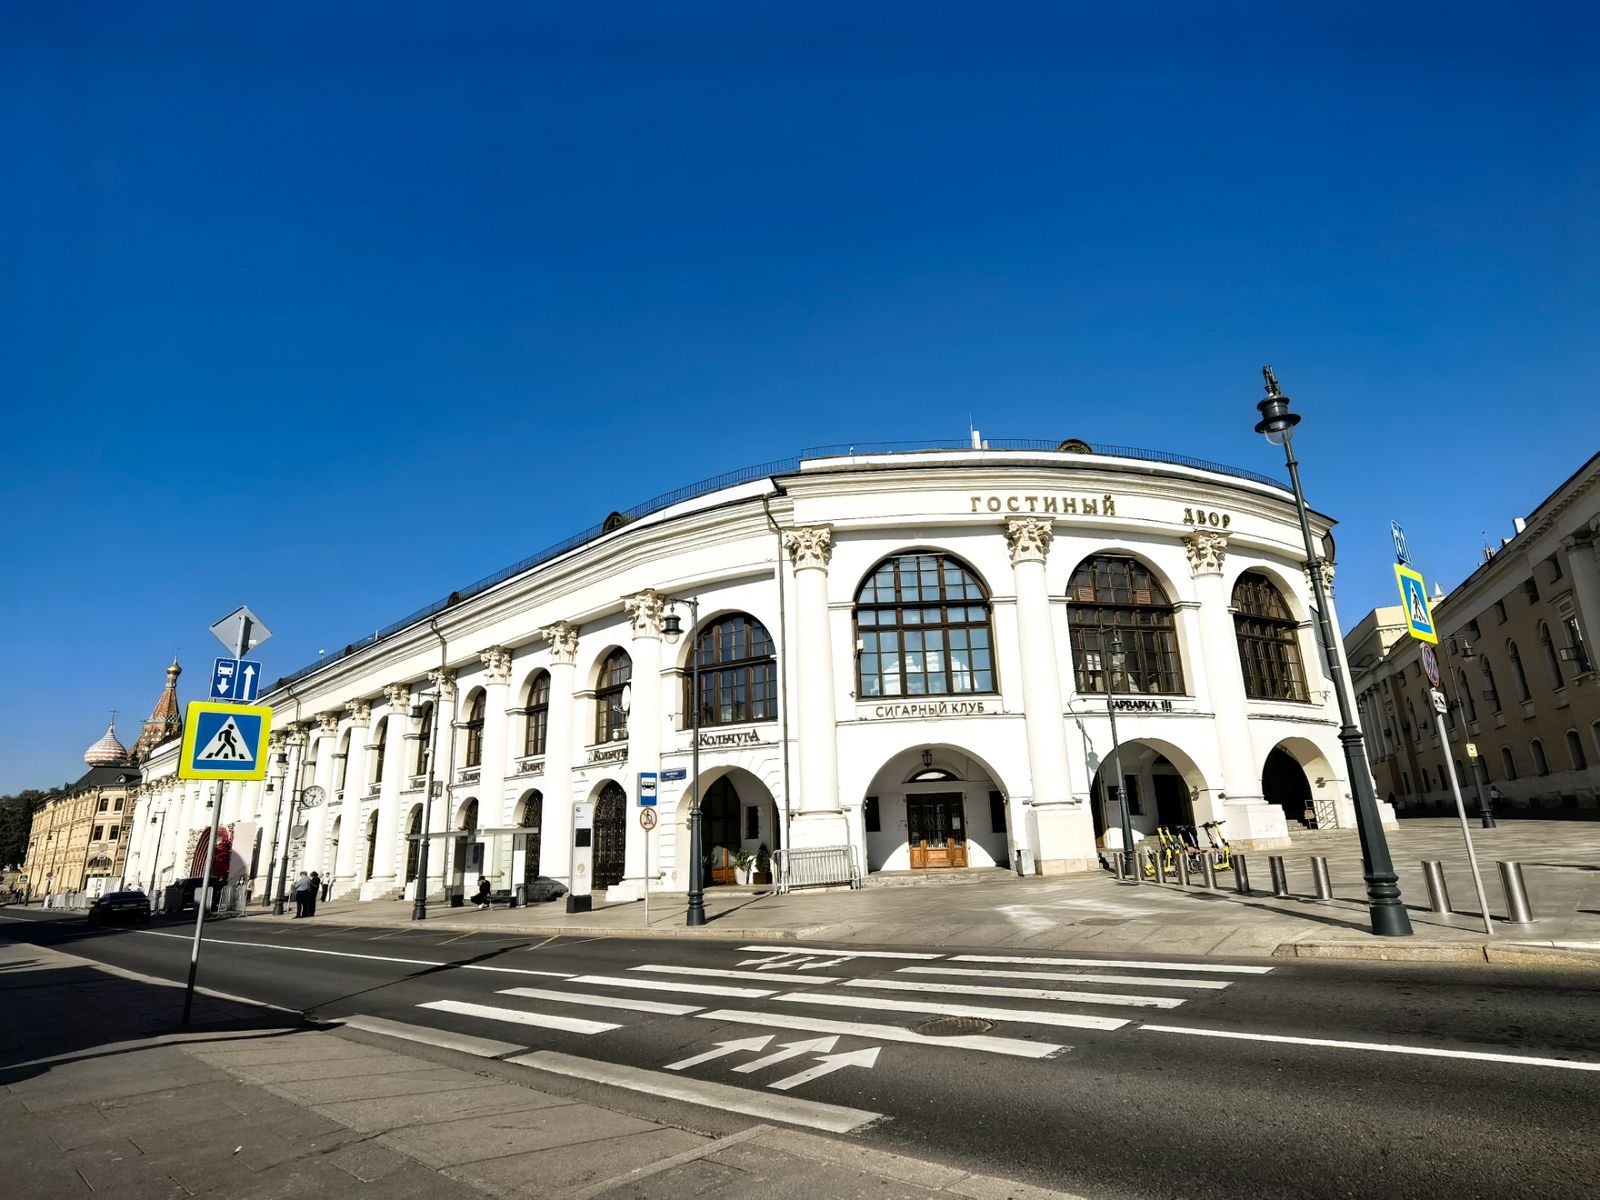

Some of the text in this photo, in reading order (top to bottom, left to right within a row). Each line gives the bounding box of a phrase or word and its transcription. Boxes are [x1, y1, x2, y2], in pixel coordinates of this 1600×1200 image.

[970, 494, 1231, 529] ГОСТИНЫЙ ДВОР
[875, 702, 985, 718] СИГАРНЫЙ КЛУБ
